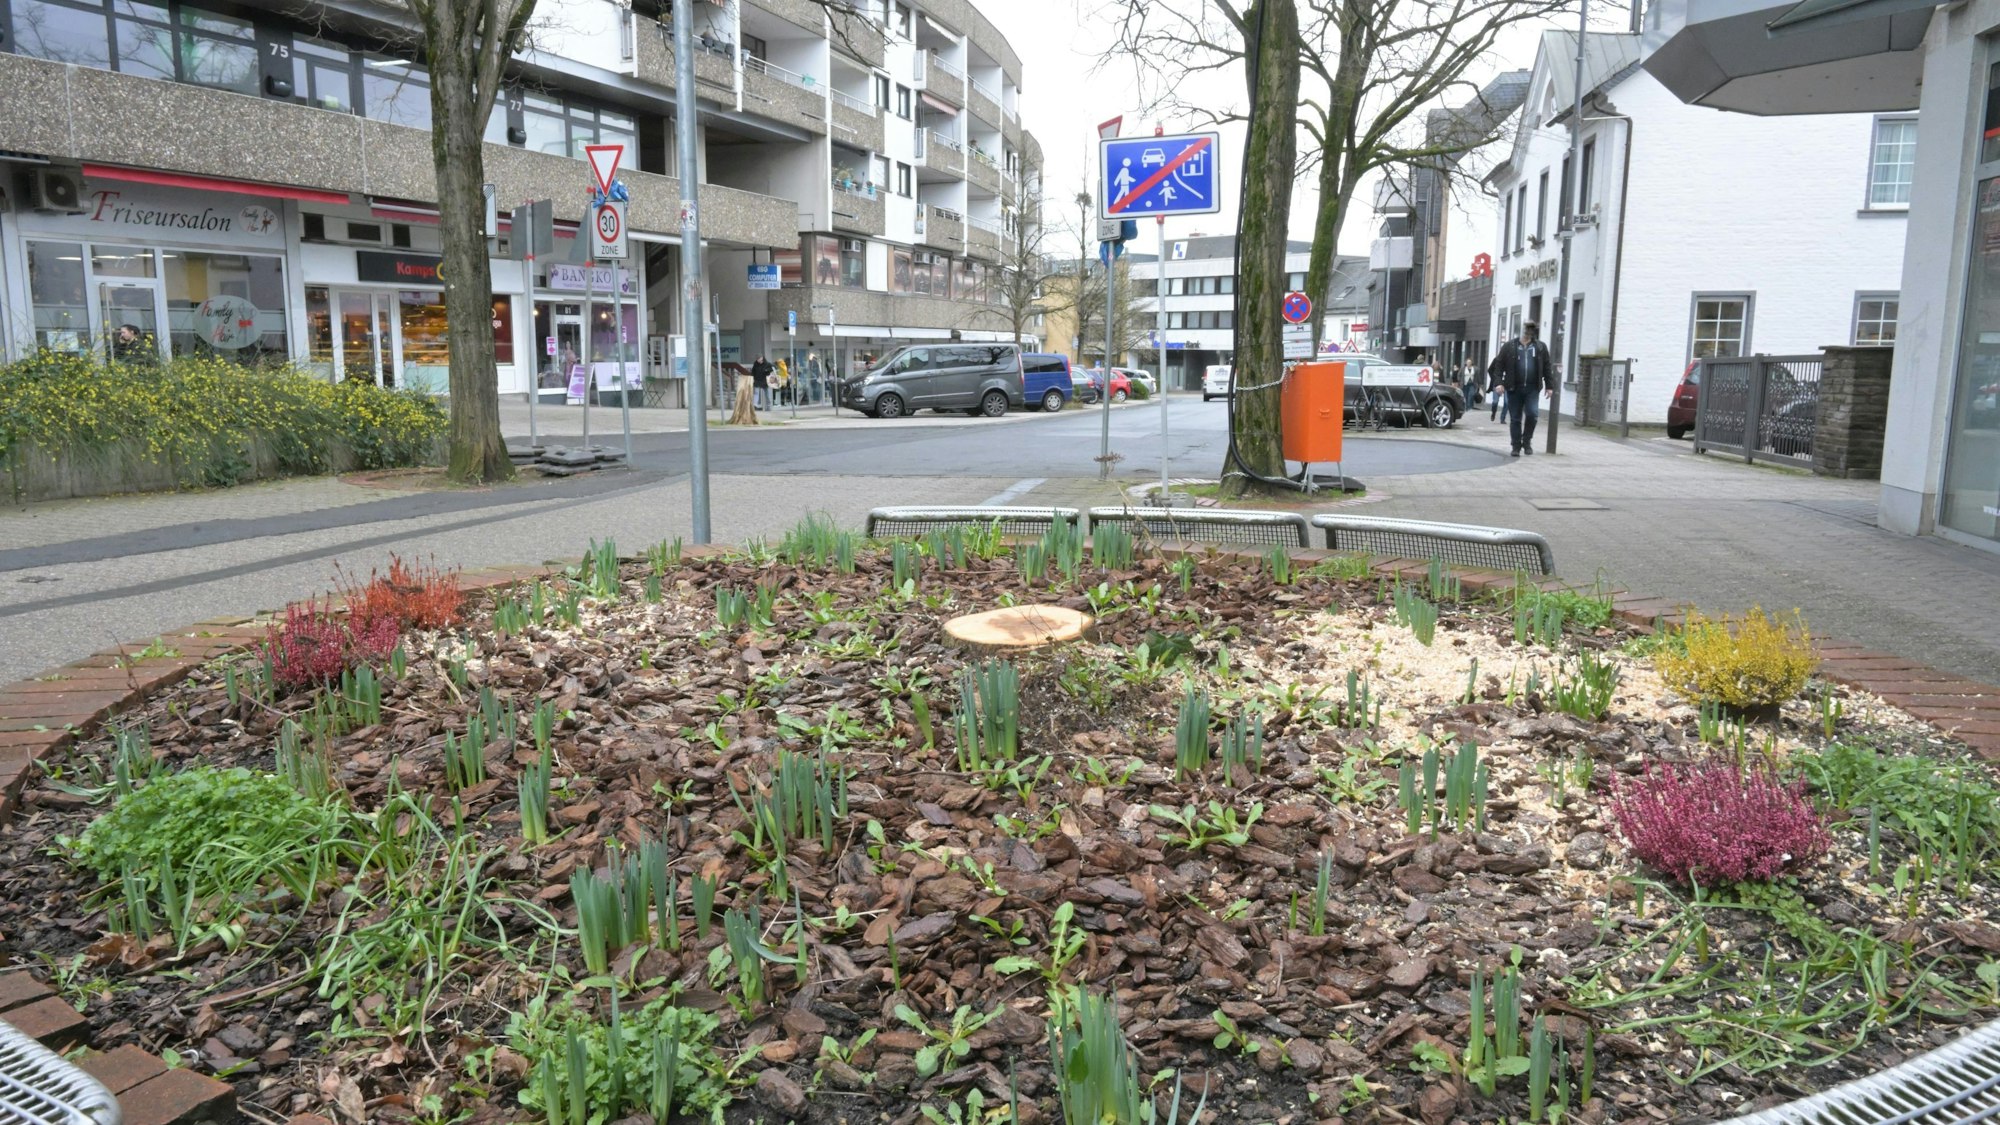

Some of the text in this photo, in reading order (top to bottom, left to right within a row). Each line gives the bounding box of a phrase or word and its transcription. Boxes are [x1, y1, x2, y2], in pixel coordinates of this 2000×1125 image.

[269, 43, 289, 58] 75
[510, 100, 523, 111] 77
[90, 190, 232, 232] Friseursalon
[601, 215, 615, 232] 30
[601, 245, 619, 255] ZONE
[396, 261, 435, 279] Kamps
[202, 299, 234, 325] Family
[213, 325, 235, 343] Hair
